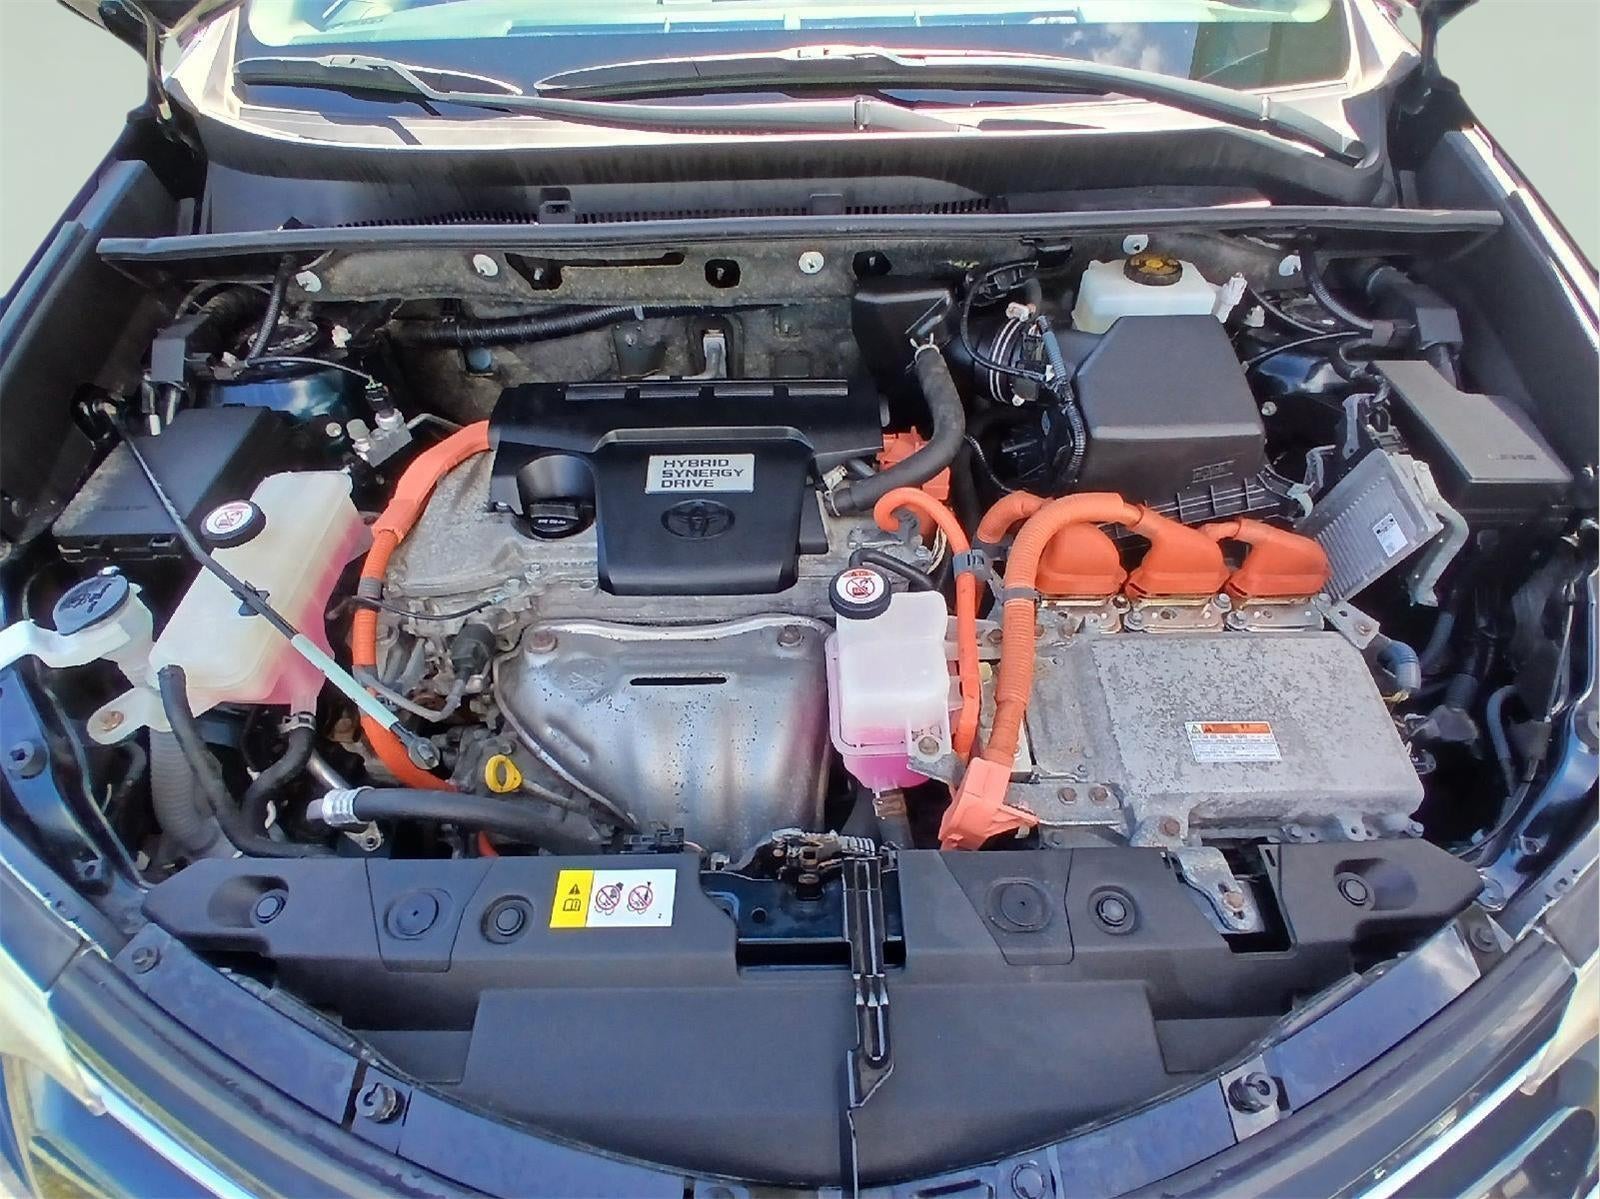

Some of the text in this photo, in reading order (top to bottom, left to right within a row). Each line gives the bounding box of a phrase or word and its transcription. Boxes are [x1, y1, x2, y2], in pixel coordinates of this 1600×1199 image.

[663, 459, 729, 468] HYBRID
[662, 469, 744, 478] SYNERGY
[661, 479, 714, 488] DRIVE
